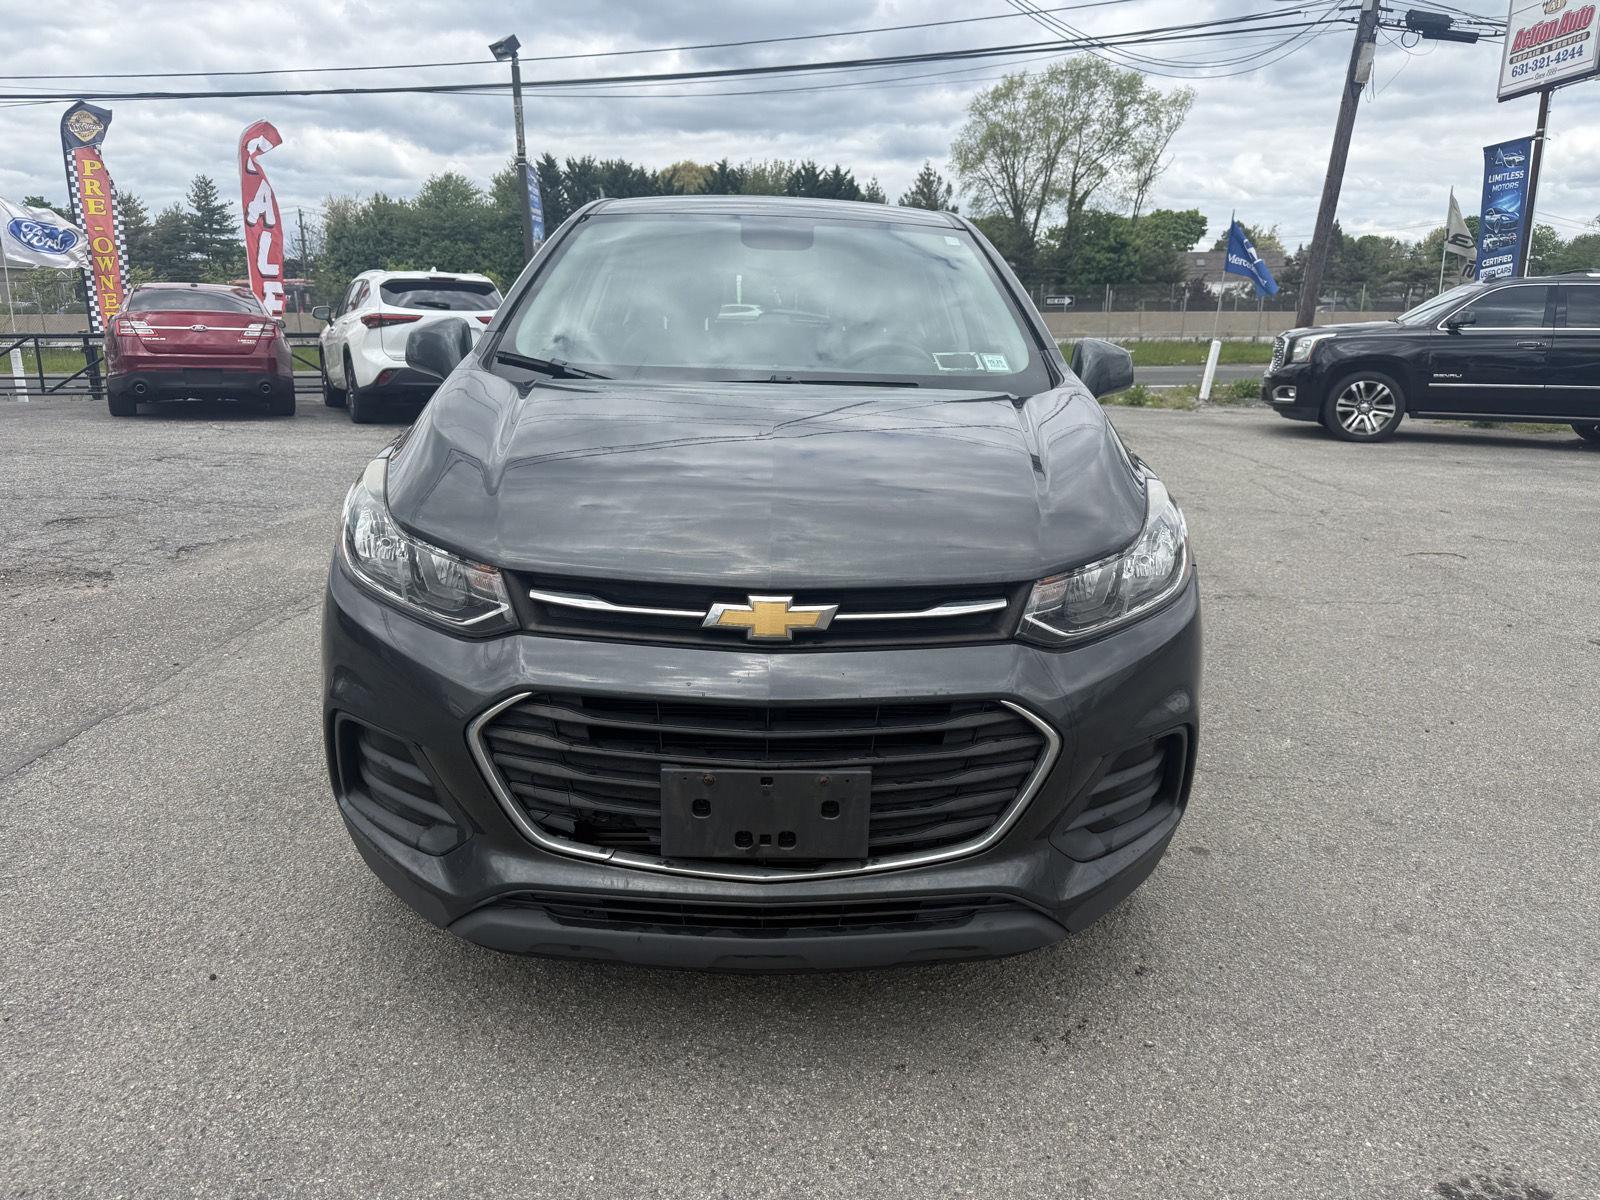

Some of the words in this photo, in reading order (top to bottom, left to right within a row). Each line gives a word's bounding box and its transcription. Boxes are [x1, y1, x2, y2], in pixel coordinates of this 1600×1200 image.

[1511, 18, 1560, 53] Action
[1558, 4, 1596, 37] Auto
[1511, 44, 1584, 78] 631-321-4244
[1488, 170, 1524, 183] LIMITLESS
[1491, 181, 1519, 192] MOTORS
[20, 222, 65, 250] Ford
[1481, 254, 1513, 267] CERTIFIED
[1496, 265, 1512, 275] CARS
